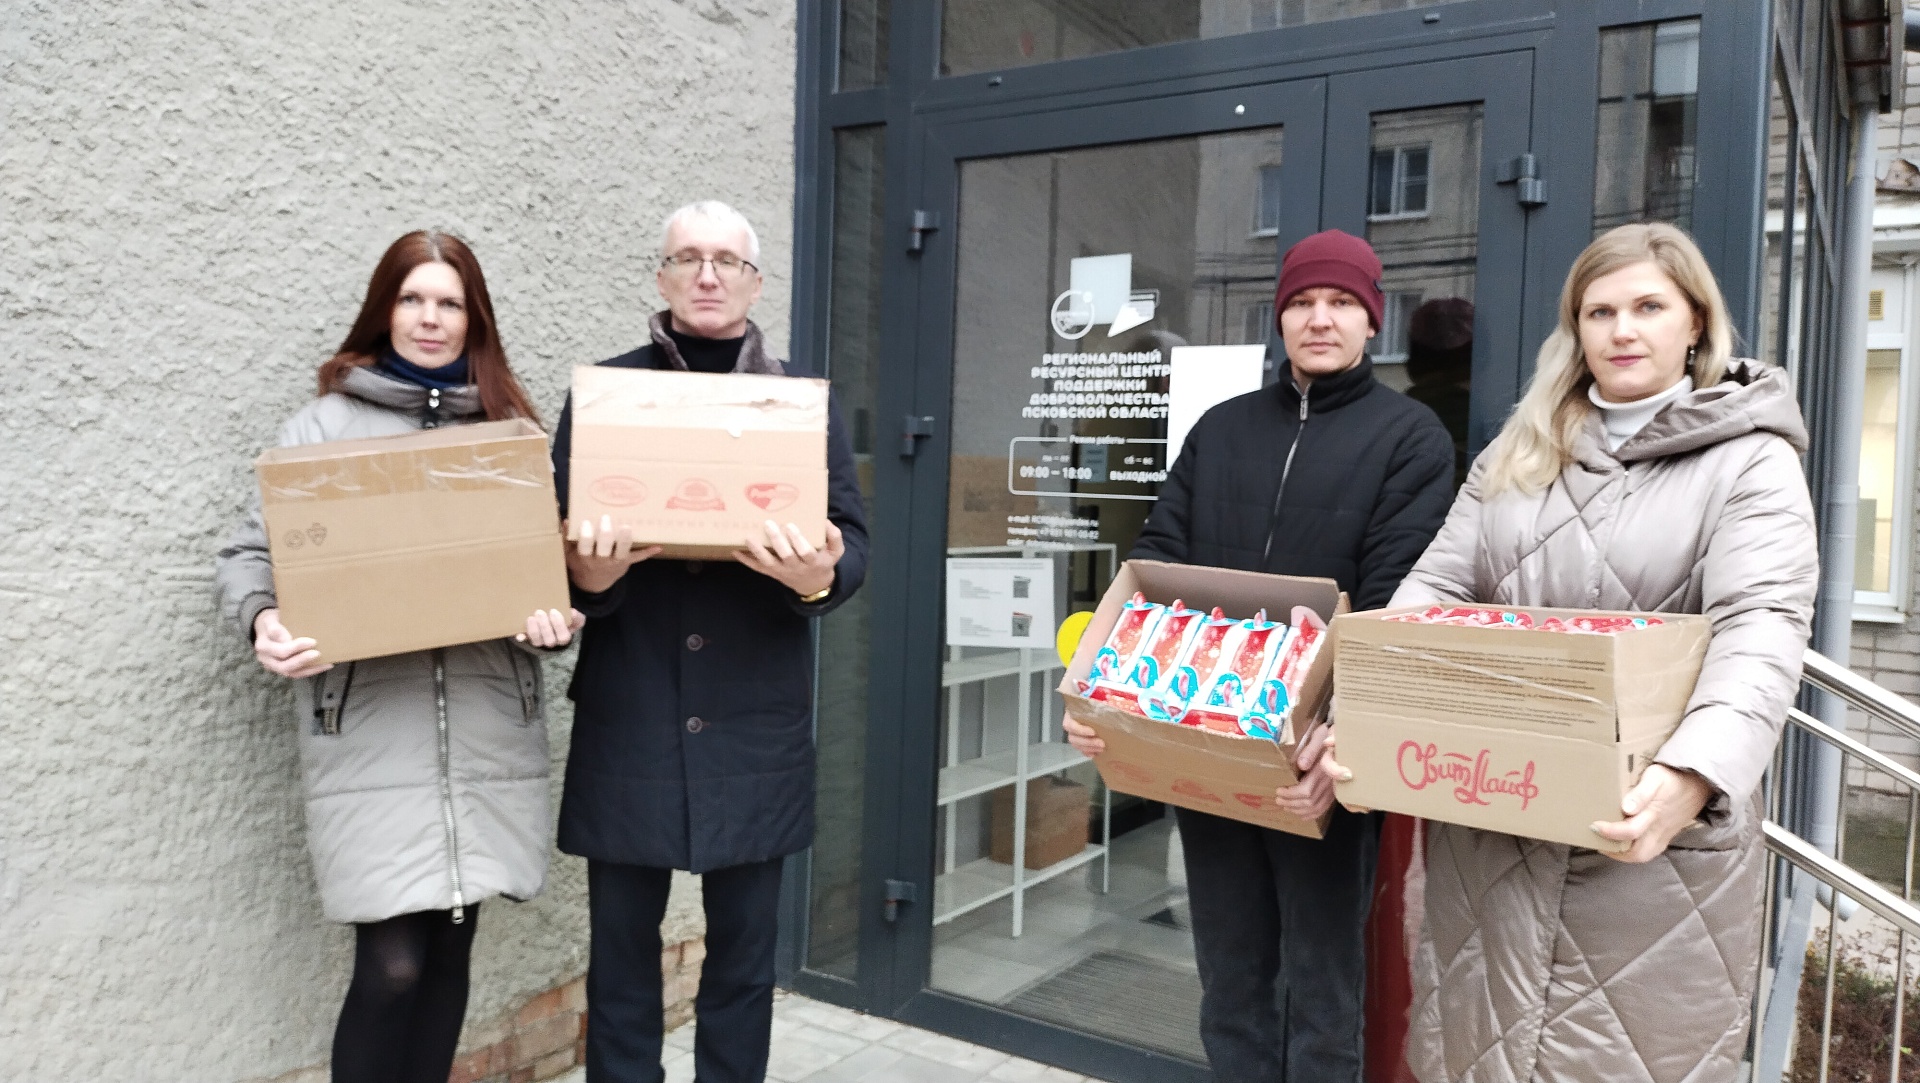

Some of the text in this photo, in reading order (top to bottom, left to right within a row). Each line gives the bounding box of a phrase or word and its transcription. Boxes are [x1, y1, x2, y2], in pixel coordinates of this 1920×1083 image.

[1042, 348, 1162, 365] РЕГИОНАЛЬНЫЙ
[1030, 363, 1170, 379] РЕСУРСНЫЙ ЦЕНТР
[1053, 378, 1147, 391] ПОДДЕРЖКИ
[1029, 392, 1170, 406] ДОБРОВОЛЬЧЕСТВА
[1021, 404, 1169, 419] ПСКОВСКОЙ ОБЛАСТ
[1019, 465, 1050, 479] 09:00
[1062, 466, 1093, 480] 18:00
